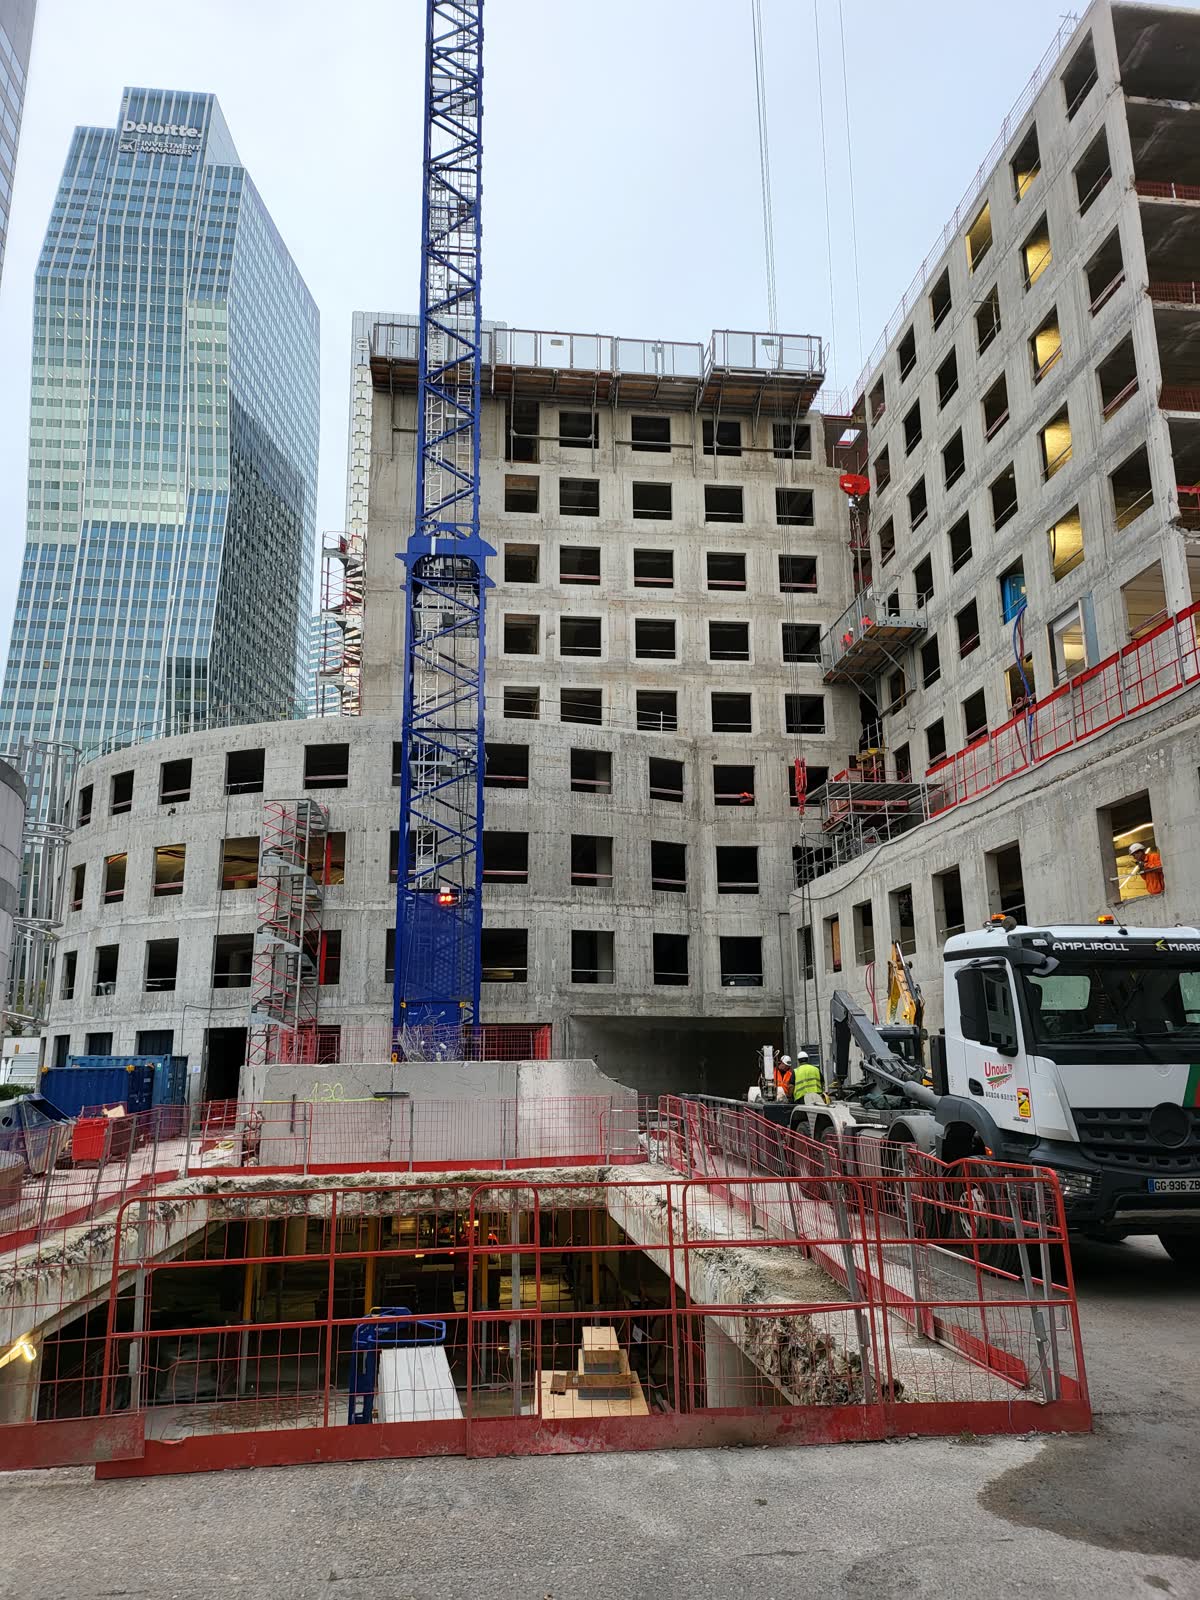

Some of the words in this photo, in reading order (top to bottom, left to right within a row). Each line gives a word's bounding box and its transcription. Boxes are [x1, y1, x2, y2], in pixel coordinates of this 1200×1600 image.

[122, 120, 203, 137] Deloitte.
[140, 146, 193, 155] MANAGERS
[141, 140, 201, 151] INVESTMENT
[1052, 942, 1129, 951] AMPLIROLL
[1154, 1180, 1200, 1191] GG-936-ZB
